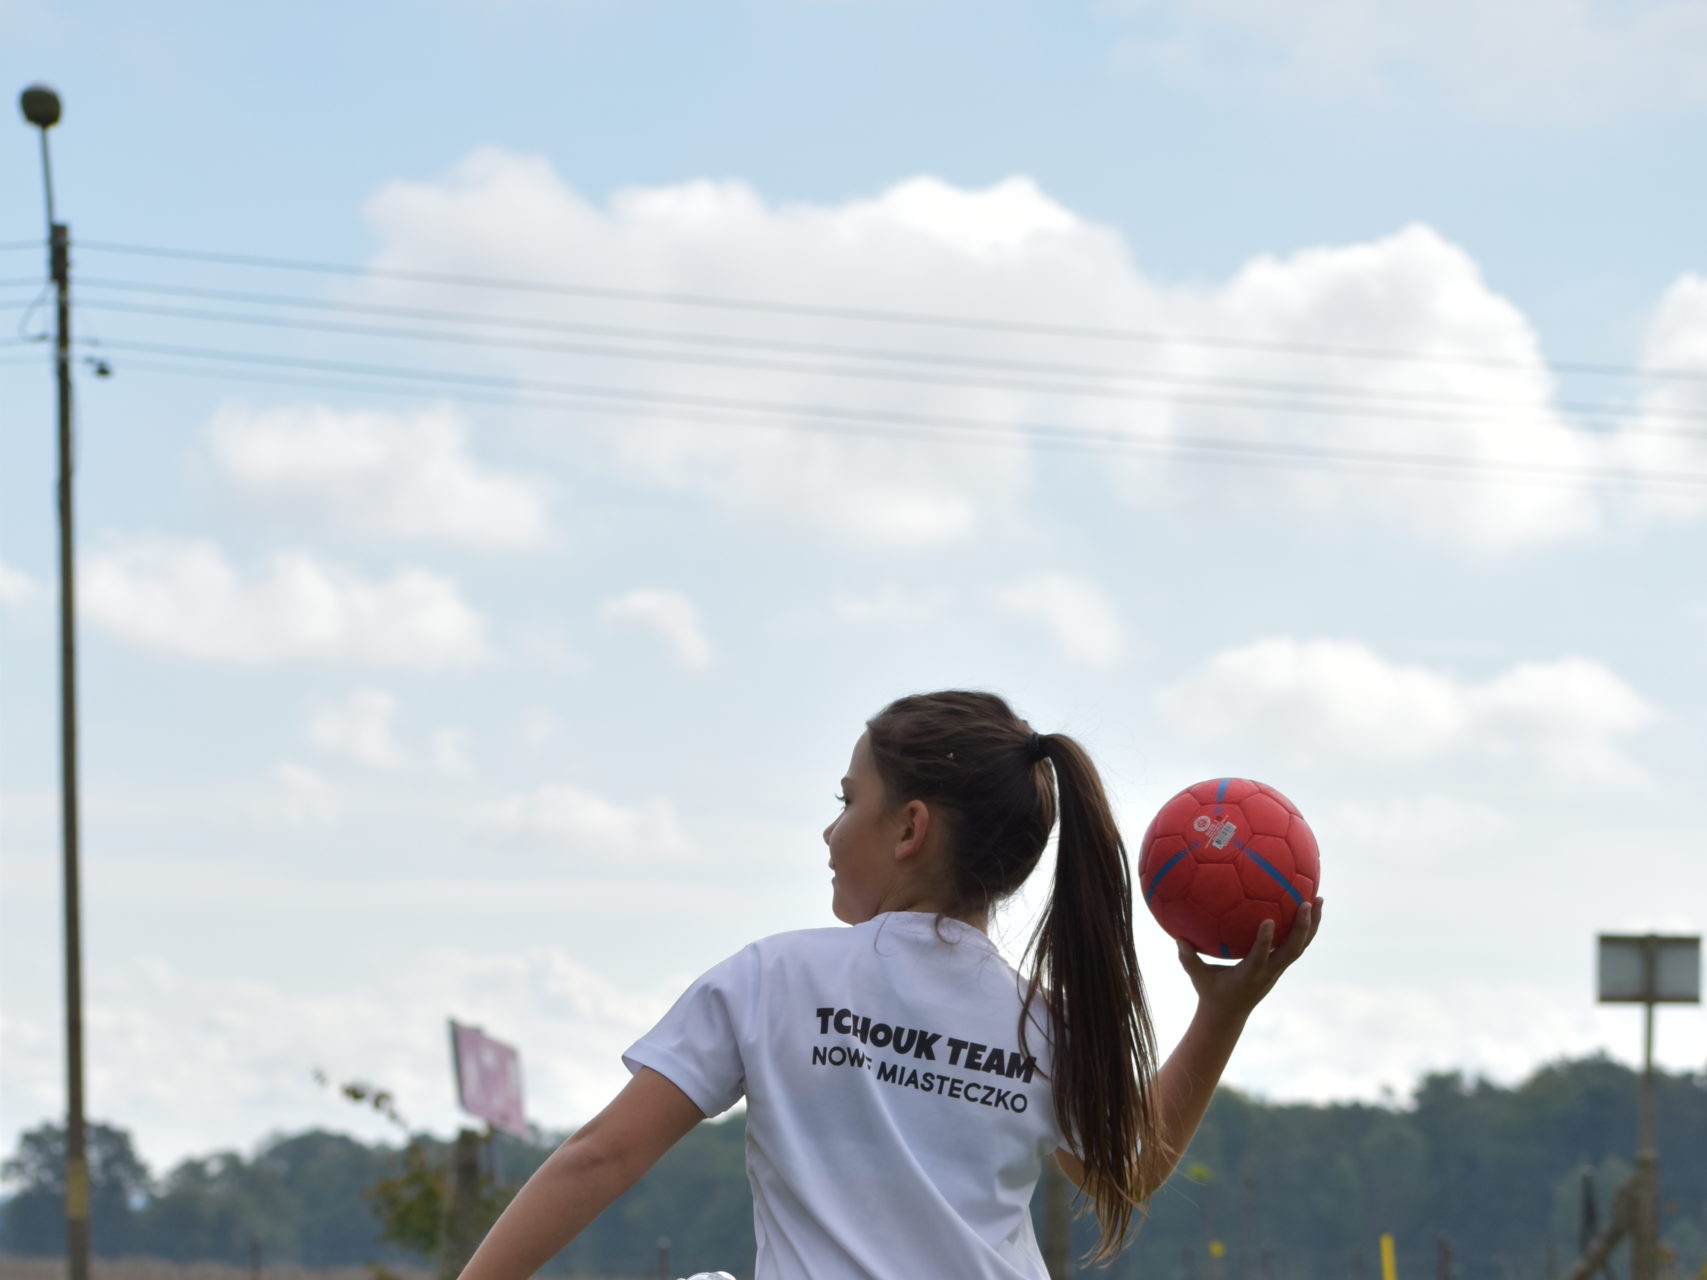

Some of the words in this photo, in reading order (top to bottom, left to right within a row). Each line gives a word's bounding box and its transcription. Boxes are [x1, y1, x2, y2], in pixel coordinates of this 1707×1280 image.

[816, 1008, 942, 1060] TCHOUK
[947, 1038, 1036, 1084] TEAM
[877, 1061, 1028, 1113] MIASTECZKO
